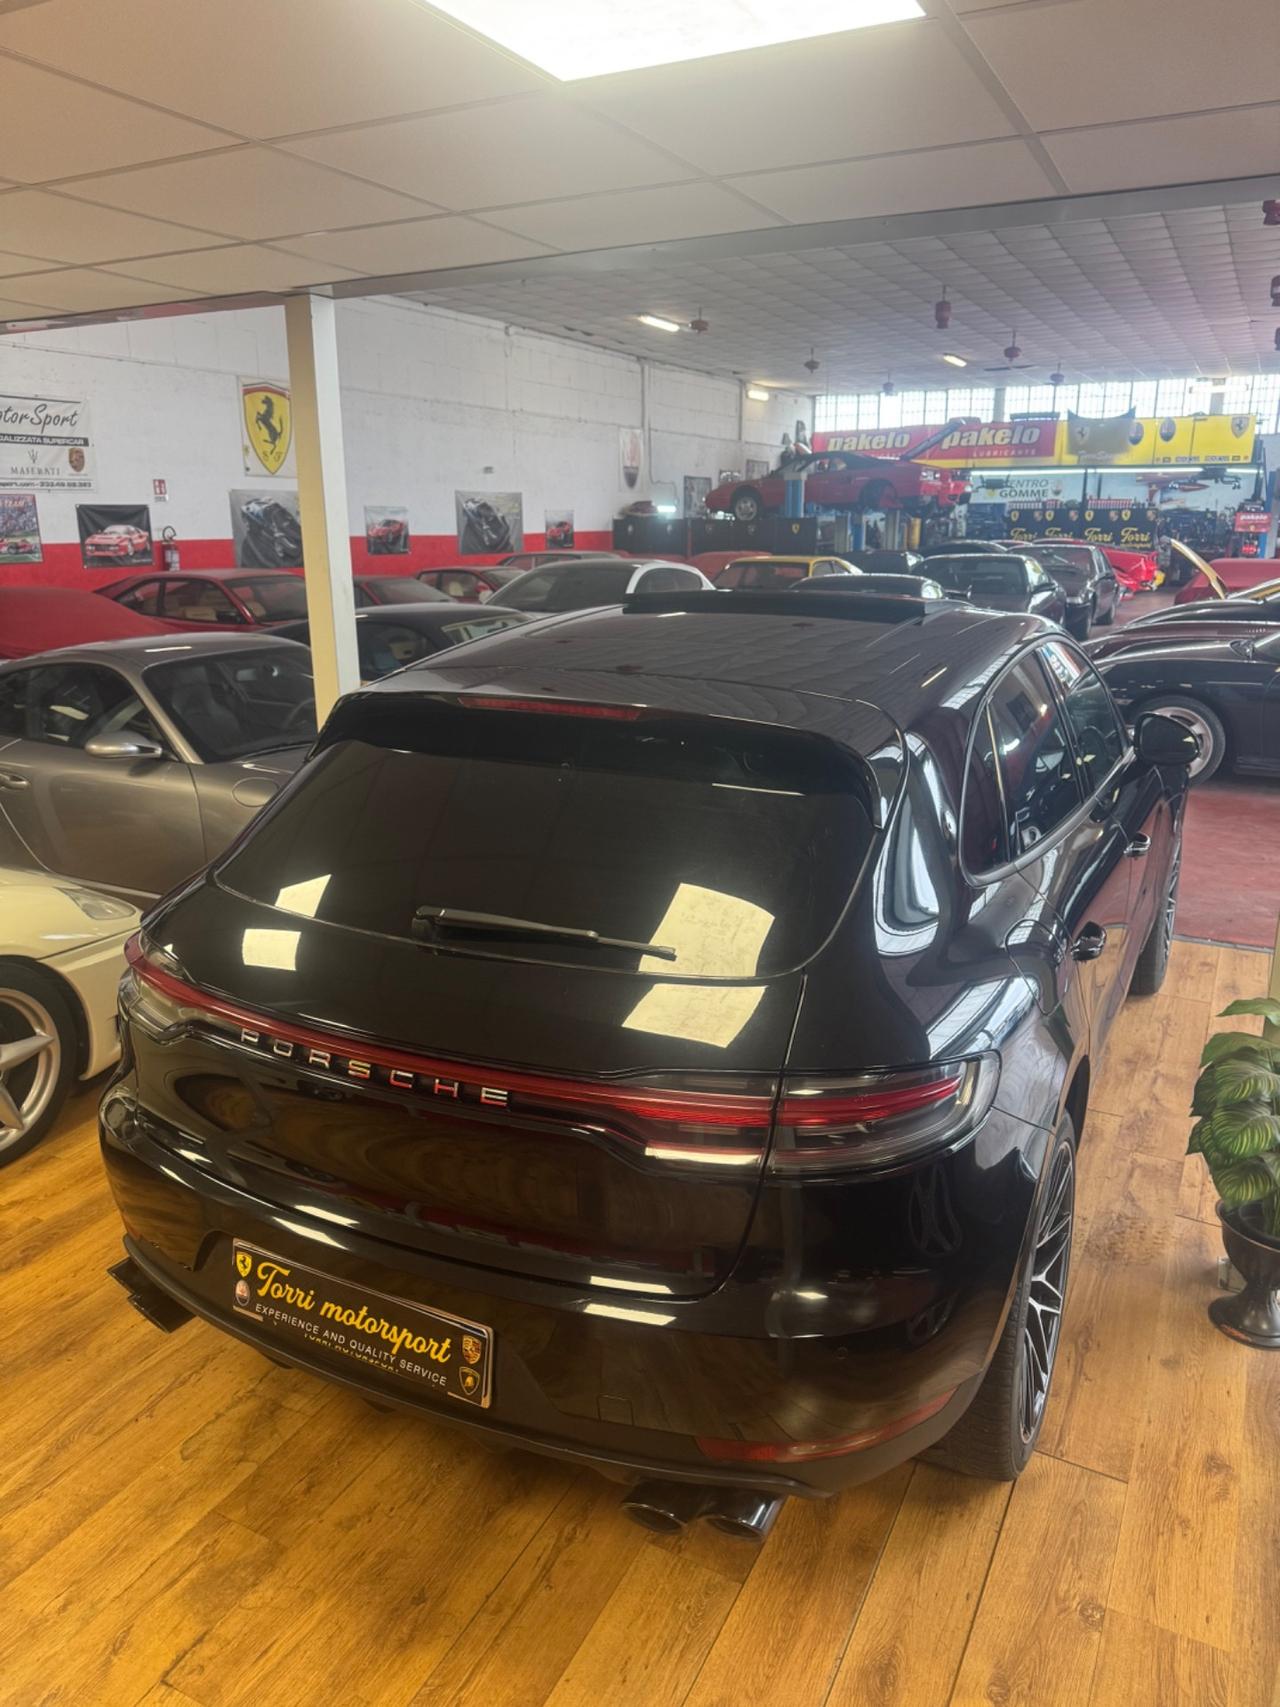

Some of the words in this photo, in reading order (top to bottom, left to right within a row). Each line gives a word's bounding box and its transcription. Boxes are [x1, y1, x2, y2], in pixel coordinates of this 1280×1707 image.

[827, 431, 911, 452] pakelo
[941, 425, 1041, 450] pakelo
[10, 466, 60, 475] MASERATI
[1009, 479, 1049, 489] ENTRO
[1000, 489, 1048, 498] GOMME
[1085, 528, 1113, 542] Torri
[1120, 527, 1151, 543] Torri
[241, 1028, 508, 1106] PORSCHE
[257, 1262, 316, 1310] Torri
[320, 1301, 451, 1363] motorsport
[255, 1303, 320, 1335] EXPERIENCE
[323, 1329, 346, 1345] AND
[349, 1338, 396, 1364] QUALITY
[399, 1358, 448, 1387] SERVICE
